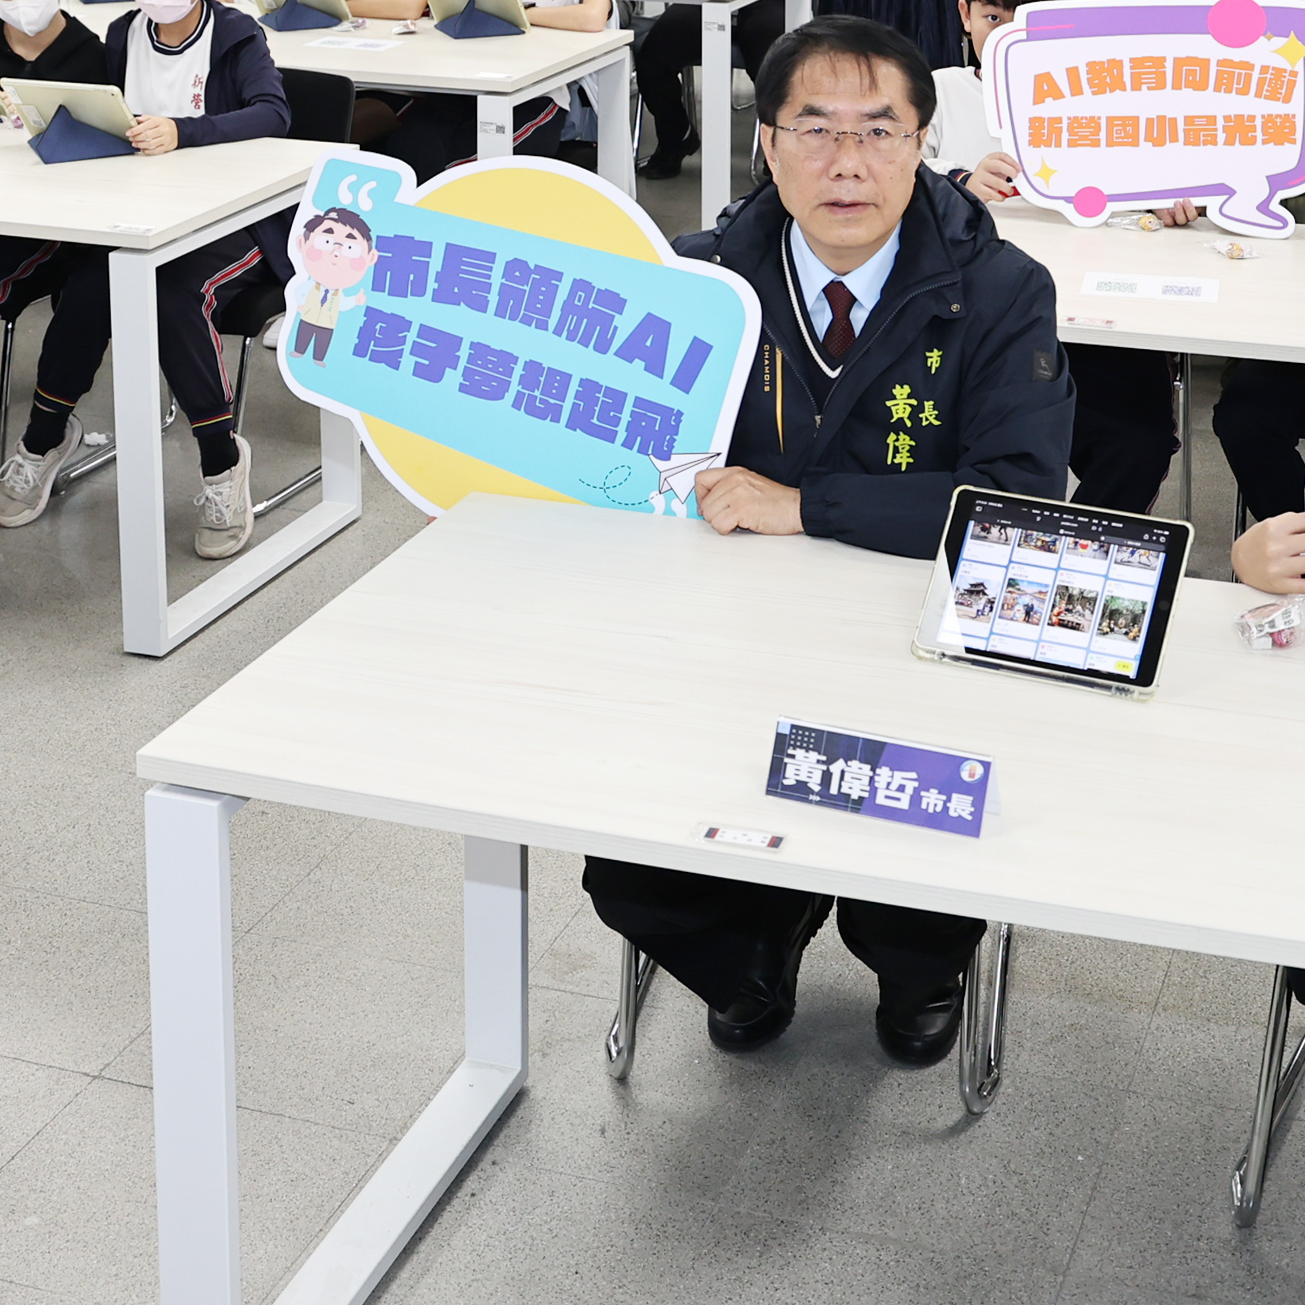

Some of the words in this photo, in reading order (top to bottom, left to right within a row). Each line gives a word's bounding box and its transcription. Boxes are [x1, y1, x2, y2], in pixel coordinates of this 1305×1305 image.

[1032, 54, 1300, 106] AI教育向前衝
[1027, 112, 1298, 149] 新營國小最光榮
[372, 234, 715, 395] 市長領航AI
[353, 306, 684, 462] 孩子夢想起飛
[885, 383, 918, 471] 黃偉
